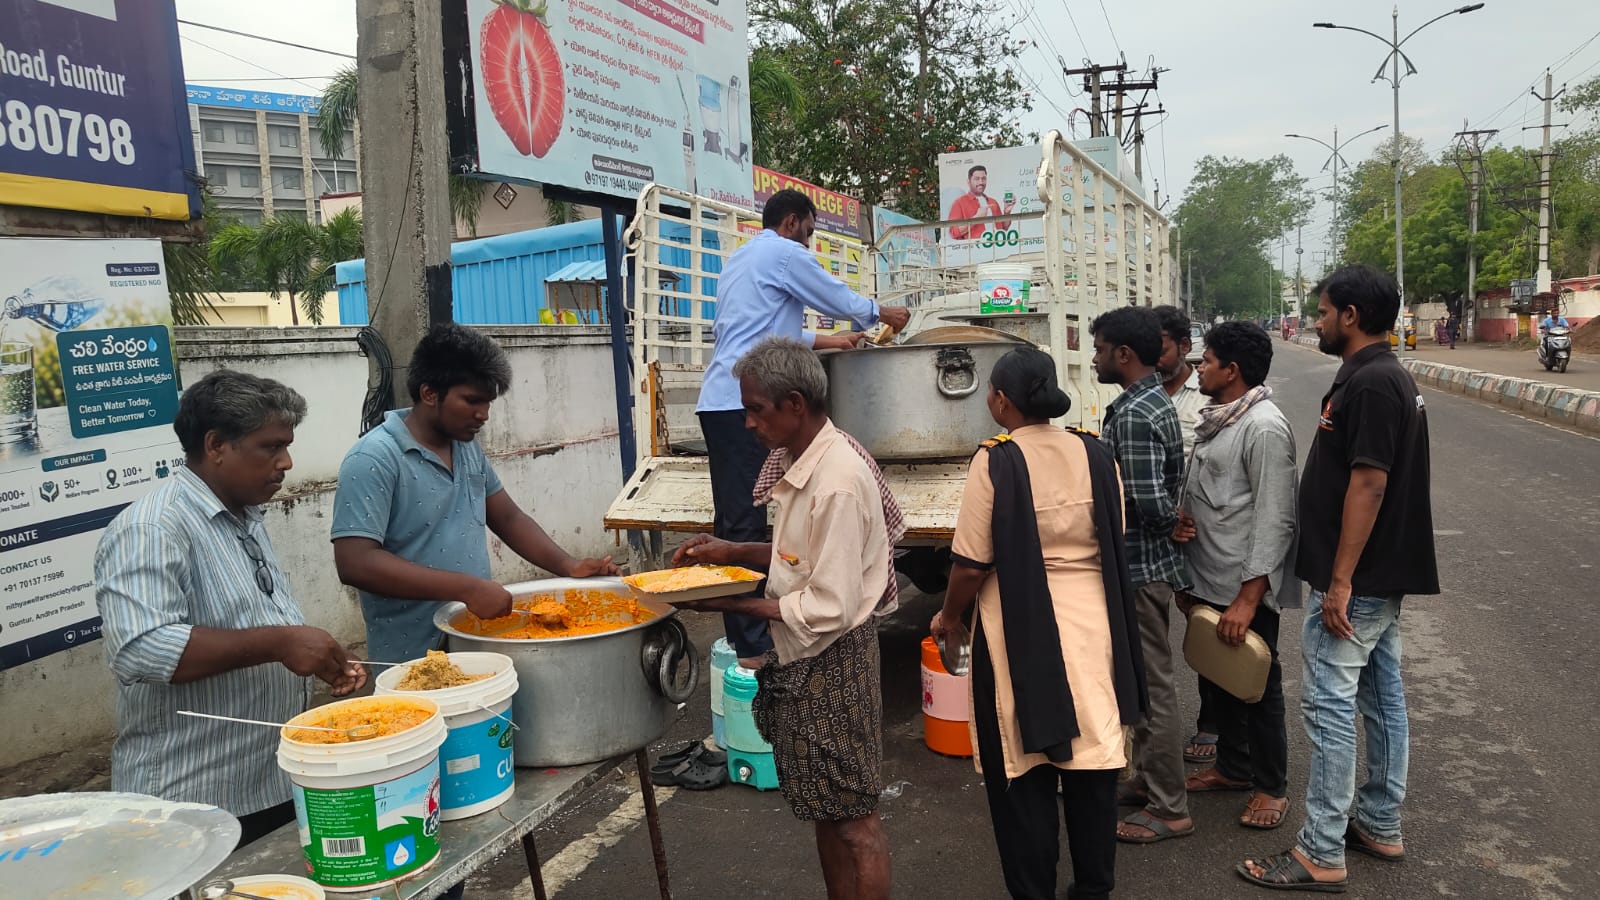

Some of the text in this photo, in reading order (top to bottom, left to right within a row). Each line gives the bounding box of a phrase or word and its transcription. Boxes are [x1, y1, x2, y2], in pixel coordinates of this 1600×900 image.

[57, 54, 126, 97] Guntur
[0, 100, 136, 166] 80798
[754, 169, 780, 196] JPS
[69, 335, 147, 358] చలి వేంద్రం
[73, 357, 160, 375] FREE WATER SERVICE
[79, 397, 152, 414] Clean Water Today,
[81, 412, 145, 428] Better Tomorrow
[54, 453, 95, 467] OUR IMPACT
[171, 457, 185, 468] 100
[122, 466, 142, 478] 100+
[64, 479, 81, 490] 50+
[0, 489, 25, 503] 000+
[0, 555, 52, 575] CONTACT US
[4, 583, 17, 592] +91
[19, 576, 41, 589] 70137
[9, 600, 86, 628] Guntur, Andhra Pradesh
